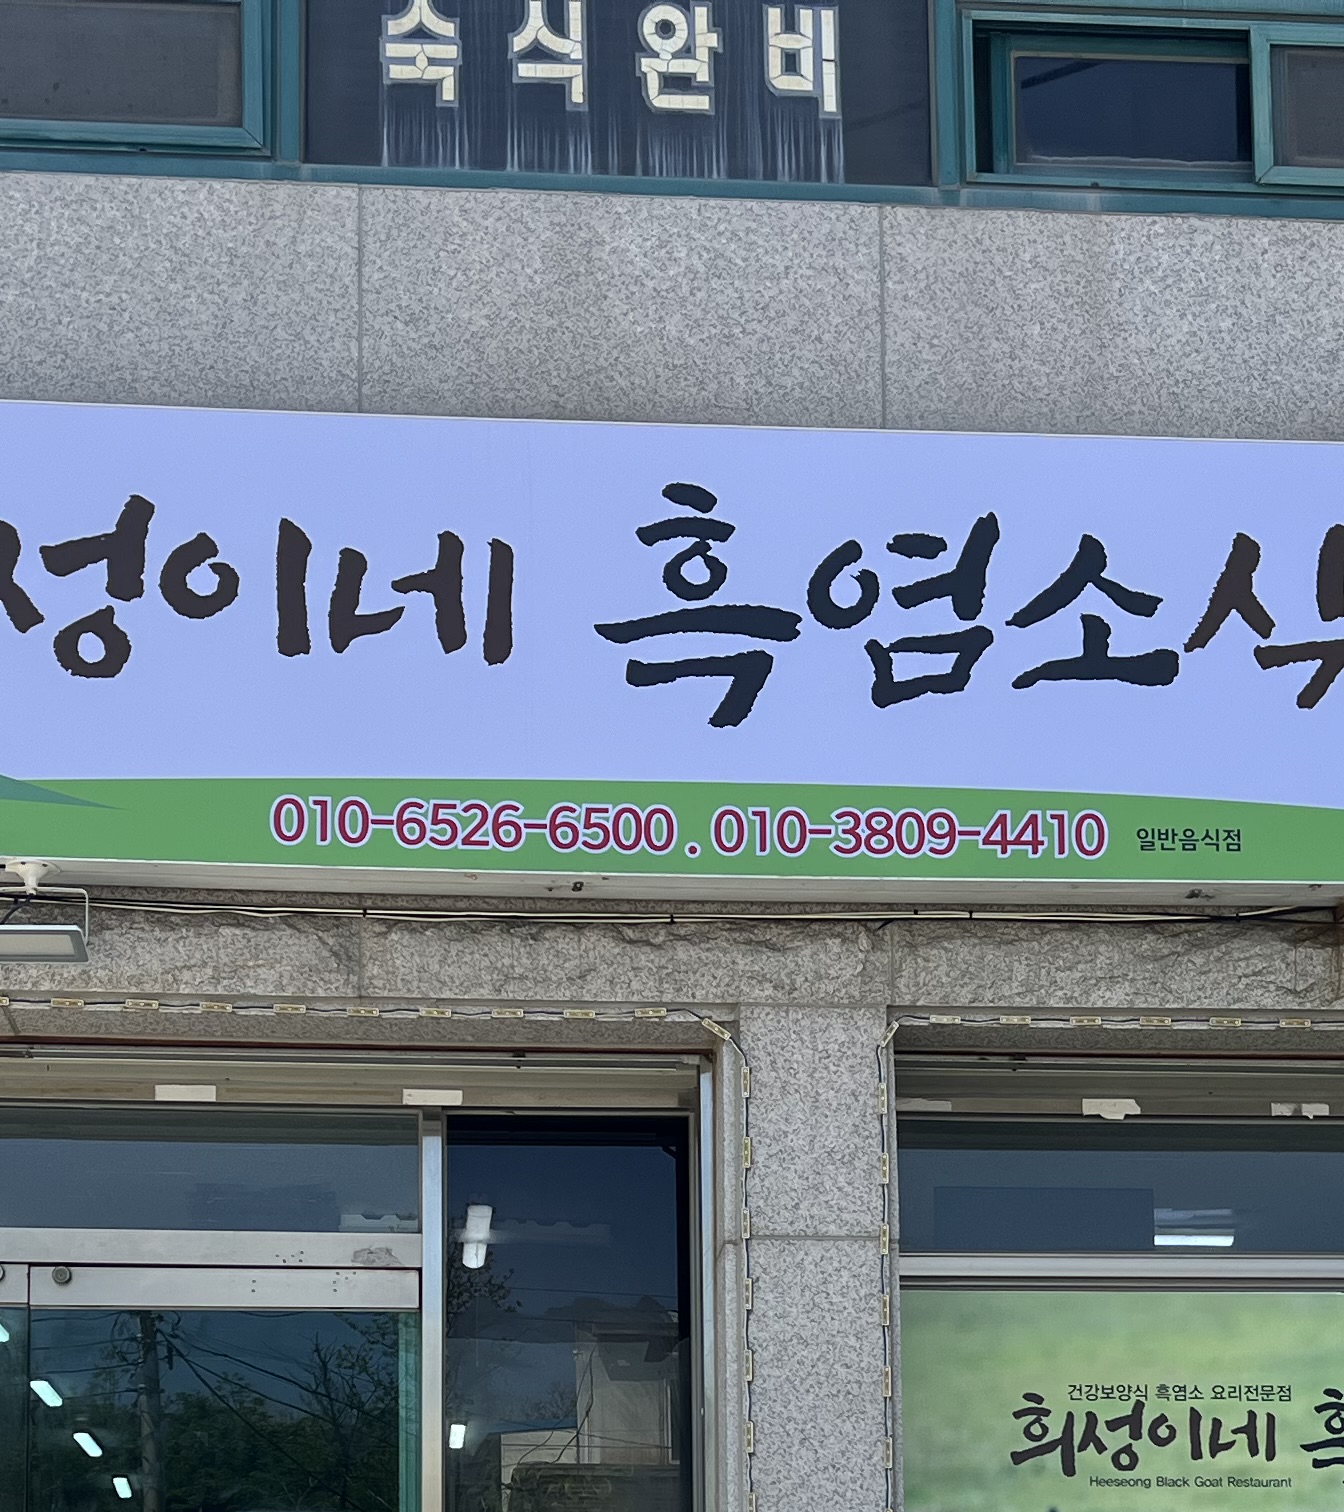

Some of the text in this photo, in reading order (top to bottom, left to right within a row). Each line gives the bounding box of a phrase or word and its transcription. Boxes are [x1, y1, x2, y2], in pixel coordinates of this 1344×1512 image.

[272, 795, 676, 853] 010-6526-6500
[711, 806, 1108, 860] 010-3809-4410
[1136, 827, 1243, 853] 일반음식점
[1067, 1383, 1293, 1402] 건강보양식 흑염소 요리전문점
[1010, 1392, 1277, 1477] 희성이네
[1089, 1475, 1293, 1489] Heeseong Black Goat Restaurant
